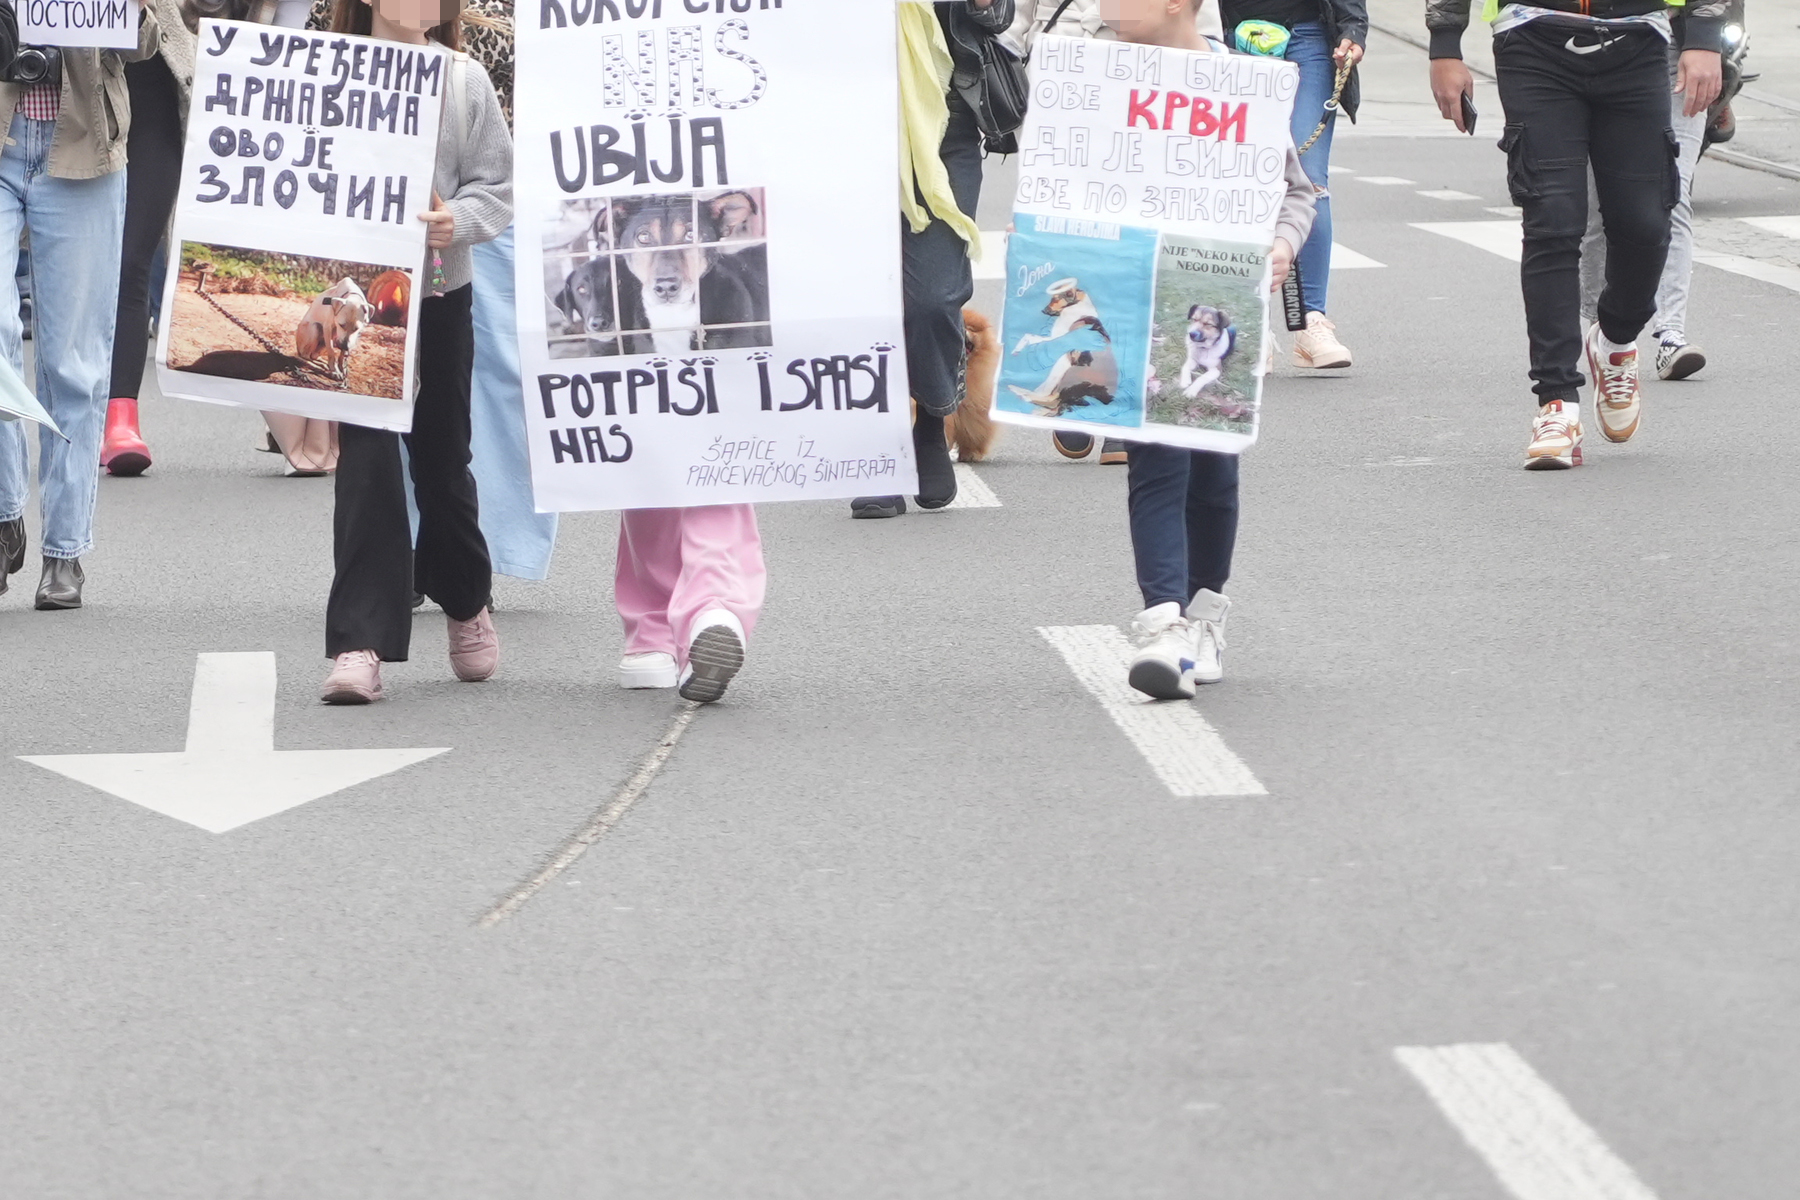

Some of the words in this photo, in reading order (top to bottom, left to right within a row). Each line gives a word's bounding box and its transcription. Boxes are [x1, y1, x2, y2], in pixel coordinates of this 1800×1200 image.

[206, 25, 239, 56] У
[250, 31, 442, 97] УРЕЂЕНИМ
[602, 18, 767, 110] NAS
[1040, 37, 1085, 73] НЕ
[1106, 45, 1162, 86] БИ
[1185, 54, 1299, 102] БИЛО
[205, 73, 419, 136] ДРЖАВАМА
[1035, 79, 1101, 111] ОВЕ
[1127, 89, 1249, 143] КРВИ
[209, 126, 284, 161] ОВО
[291, 135, 334, 171] ЈЕ
[550, 112, 728, 193] UBIJA
[1023, 126, 1090, 167] ДА
[1102, 131, 1144, 173] ЈЕ
[1165, 135, 1282, 185] БИЛО
[196, 164, 408, 225] ЗЛОЧИН
[1016, 176, 1071, 210] СВЕ
[1084, 181, 1127, 214] ПО
[1140, 185, 1283, 225] ЗАКОНУ
[1162, 245, 1189, 257] NIJE
[1176, 260, 1209, 272] NEGO
[1211, 264, 1250, 277] DONA!
[538, 360, 719, 419] POTPIŠI
[779, 346, 892, 413] SPASI
[550, 424, 633, 464] NAS
[686, 460, 807, 489] PANČEVAČKOG
[813, 456, 896, 482] ŠINTERAJA
[702, 437, 777, 462] ŠAPICE
[797, 438, 818, 459] IZ
